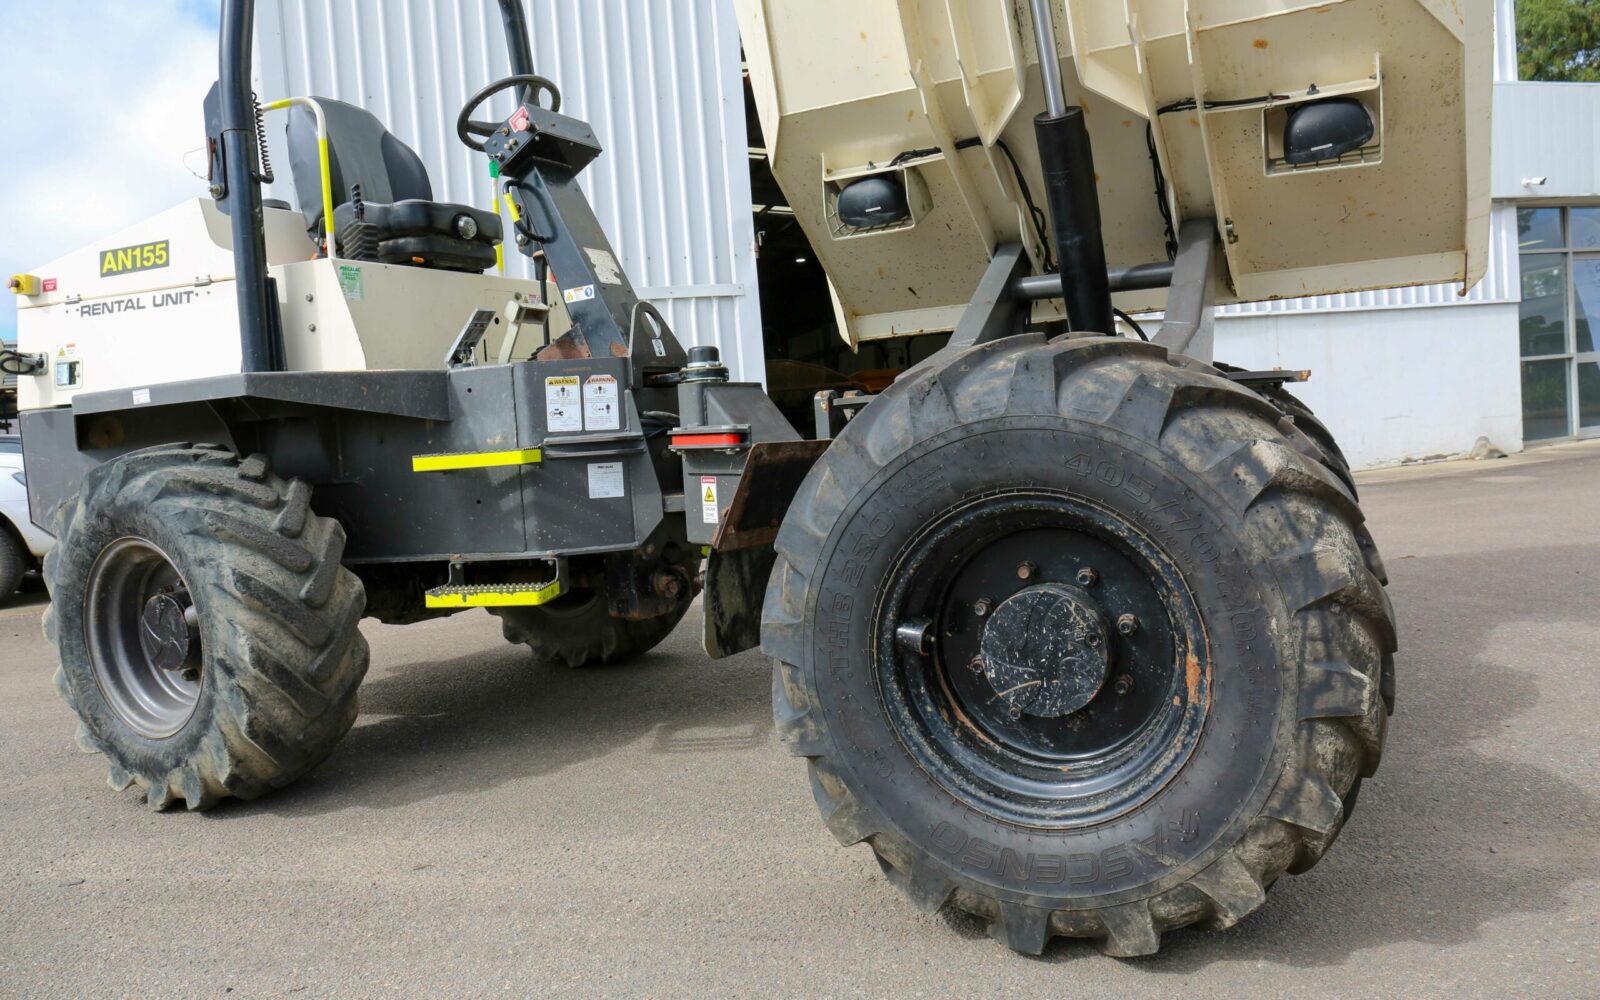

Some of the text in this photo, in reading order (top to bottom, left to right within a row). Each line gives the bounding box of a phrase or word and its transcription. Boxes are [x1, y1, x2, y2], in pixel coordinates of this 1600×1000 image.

[101, 242, 168, 274] AN155
[80, 290, 194, 317] RENTAL UNIT
